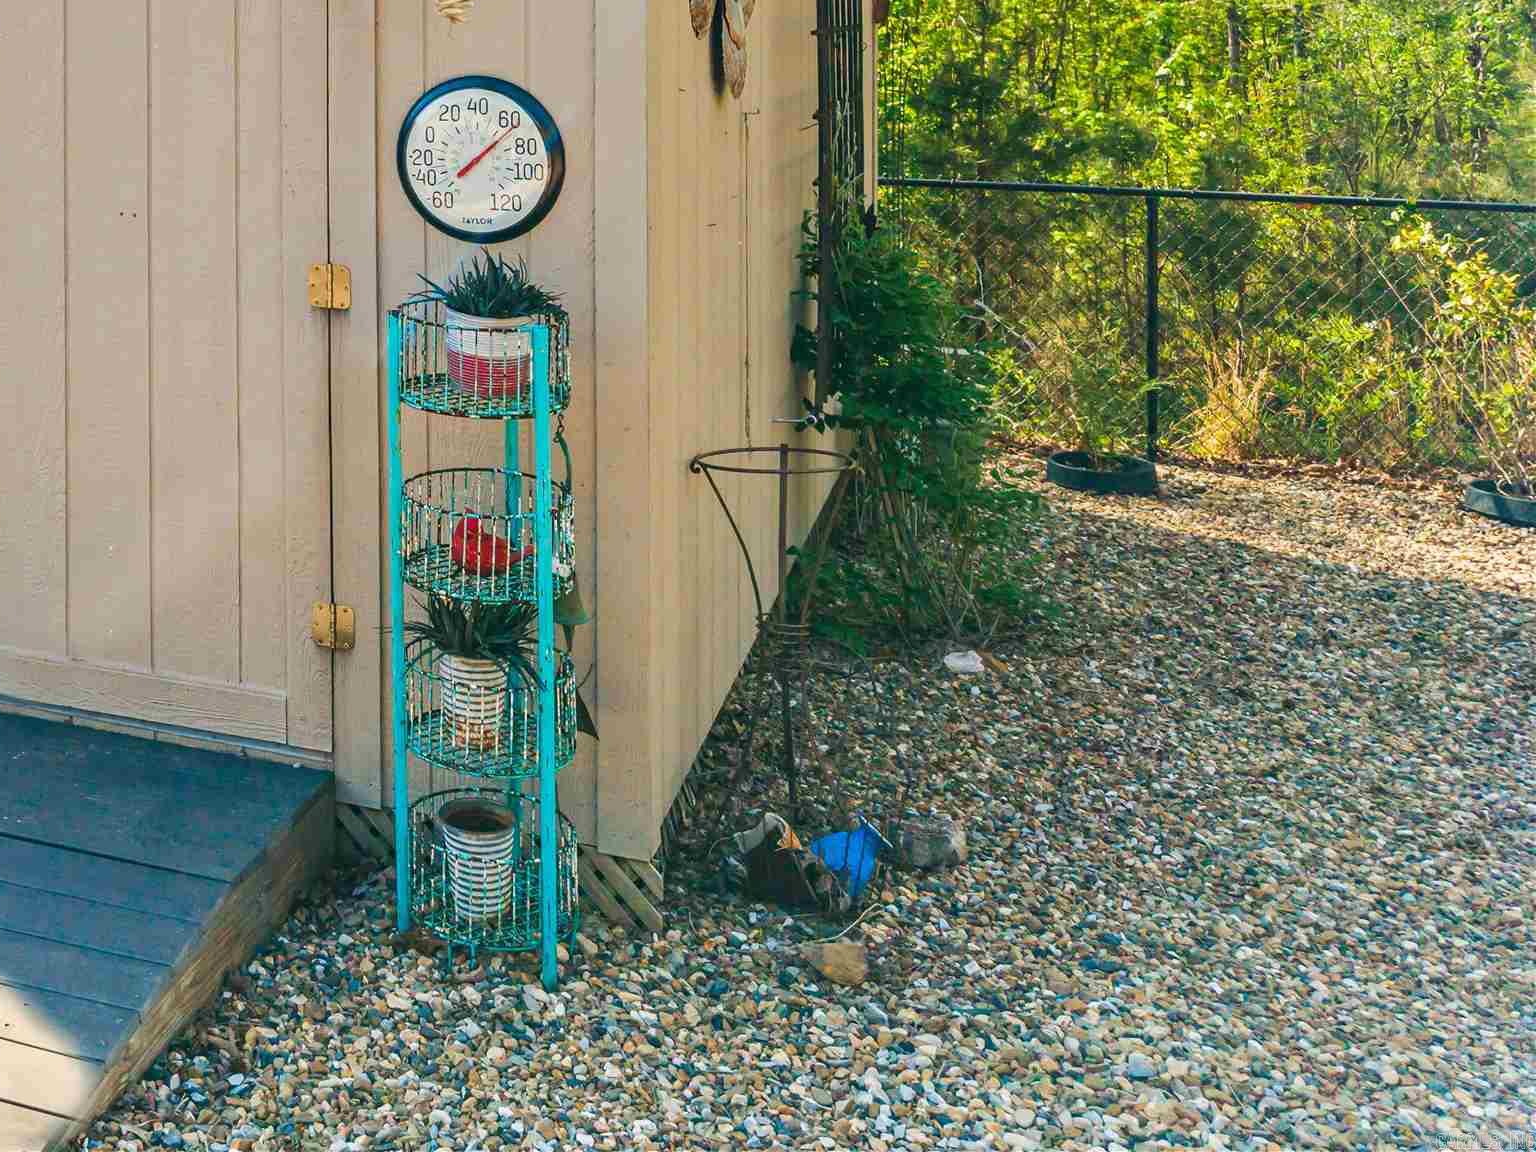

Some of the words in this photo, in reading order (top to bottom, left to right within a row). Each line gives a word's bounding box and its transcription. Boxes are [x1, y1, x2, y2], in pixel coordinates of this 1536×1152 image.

[439, 104, 461, 122] 20
[467, 97, 489, 115] 40
[498, 110, 521, 128] 60
[425, 126, 435, 143] 0
[515, 137, 537, 155] 80
[514, 163, 544, 181] 100
[490, 193, 522, 212] 120
[462, 217, 493, 225] TAYLOR
